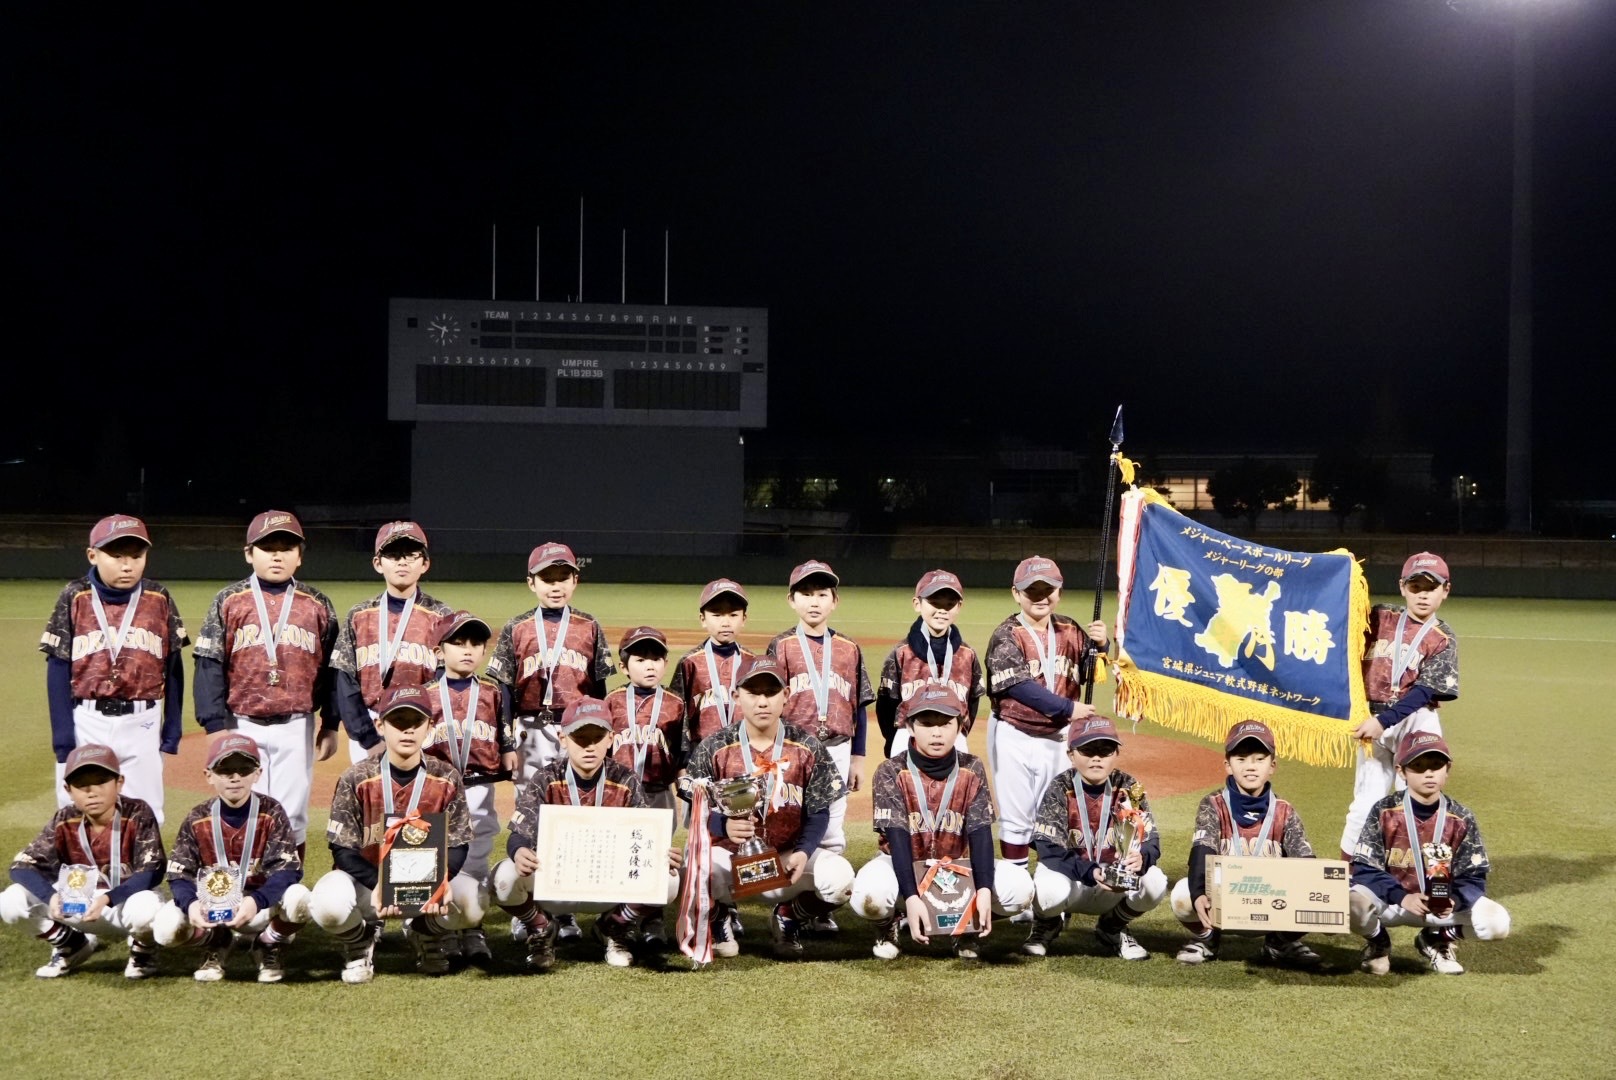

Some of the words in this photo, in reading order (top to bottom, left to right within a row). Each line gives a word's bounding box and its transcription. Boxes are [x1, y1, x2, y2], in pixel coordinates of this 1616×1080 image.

[484, 310, 509, 319] TEAM
[1180, 526, 1312, 568] メジャーベースボールリーグ
[1202, 550, 1284, 578] メジャーリーグの部
[1162, 656, 1321, 706] 宮城県ジュニア軟式野球ネットワーク
[628, 829, 643, 880] 総合優勝
[1309, 892, 1330, 903] 22g
